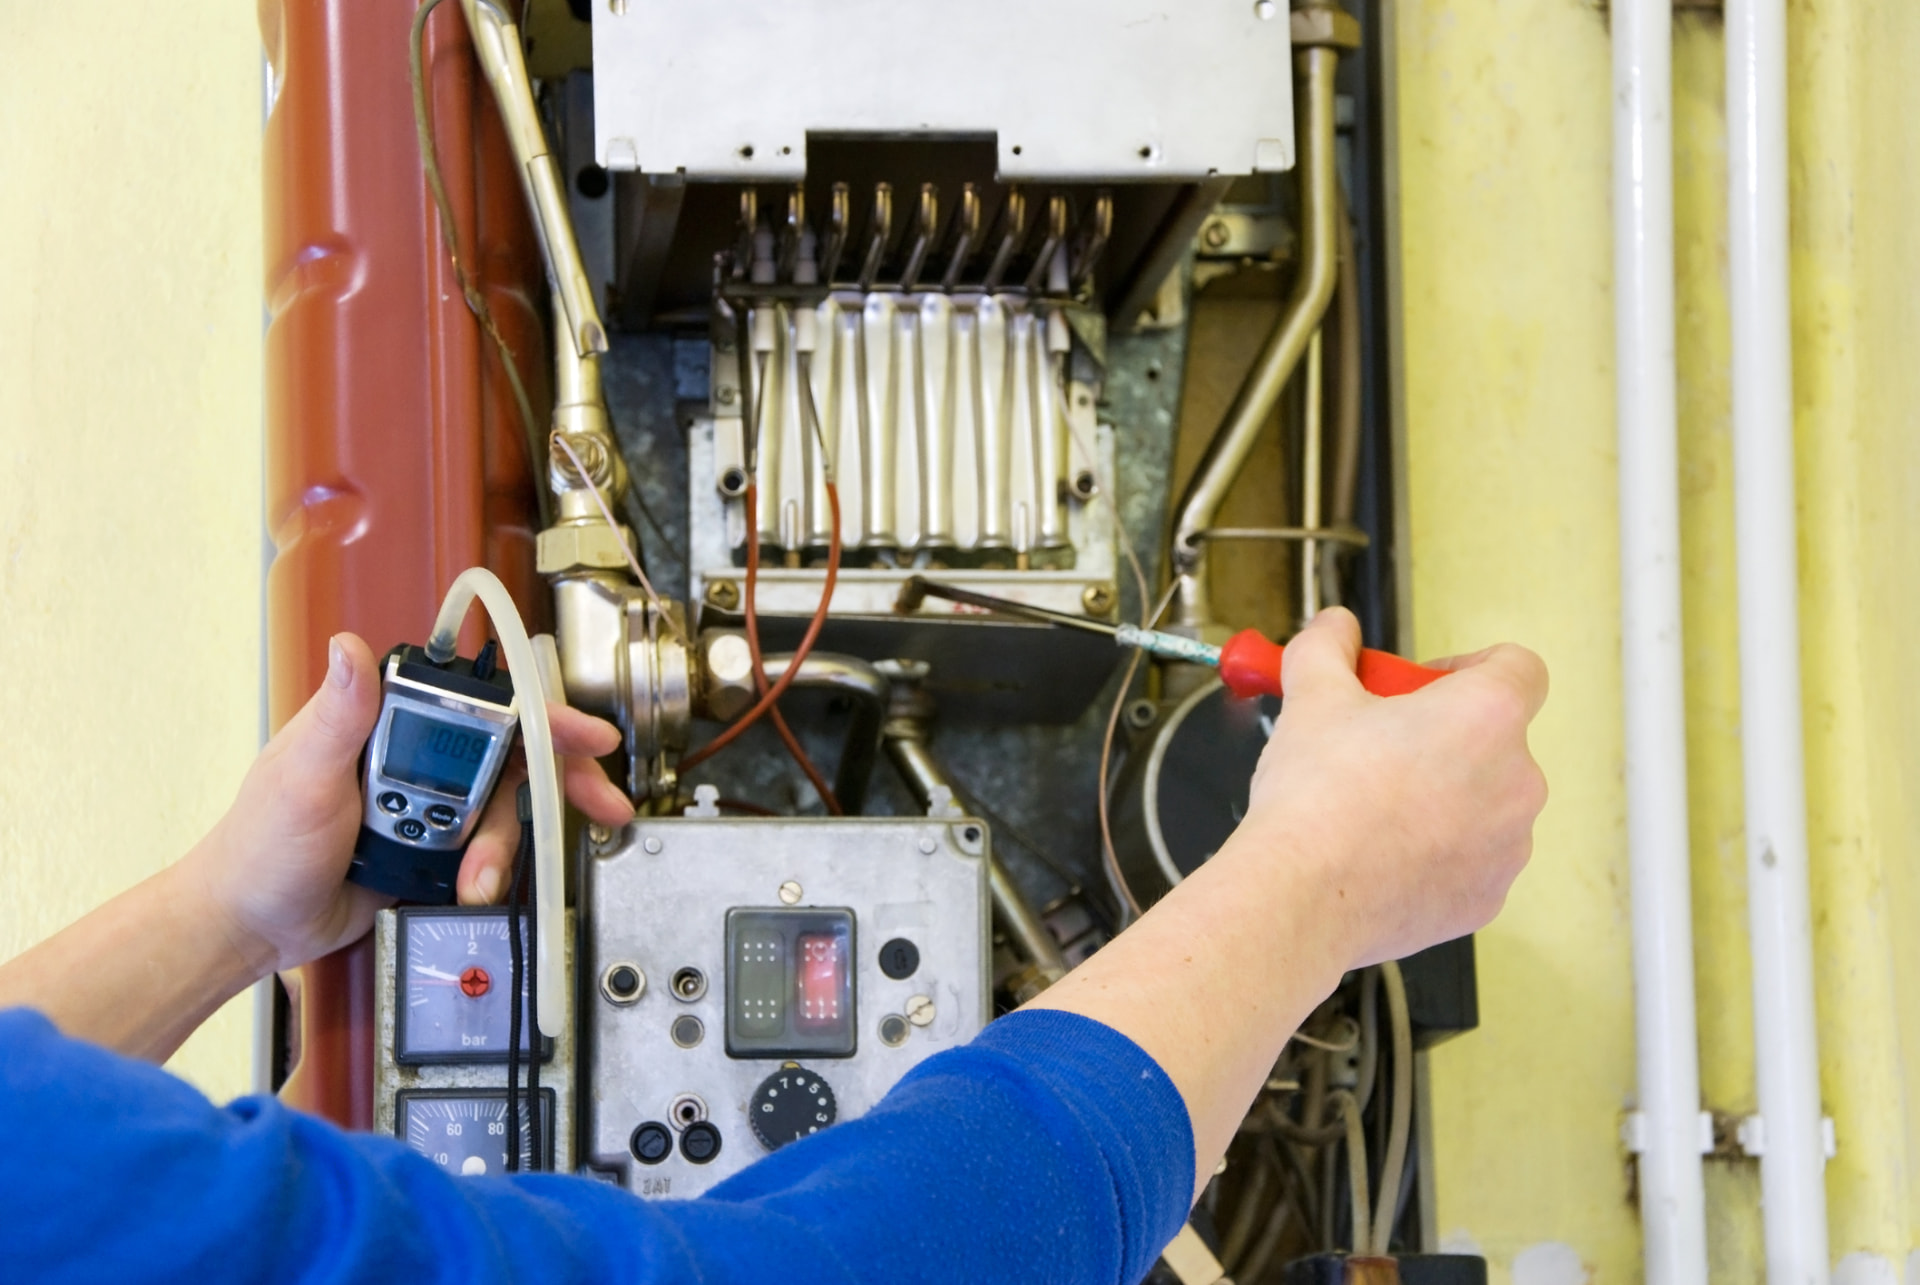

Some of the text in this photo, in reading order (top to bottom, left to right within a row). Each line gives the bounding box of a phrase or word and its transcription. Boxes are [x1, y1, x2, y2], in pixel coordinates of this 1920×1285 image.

[431, 811, 451, 821] Mode
[467, 941, 478, 955] 2
[462, 1033, 487, 1046] bar
[779, 1077, 788, 1089] 7
[808, 1082, 821, 1094] 5
[816, 1112, 828, 1122] 3
[446, 1123, 462, 1136] 60
[488, 1122, 504, 1135] 80
